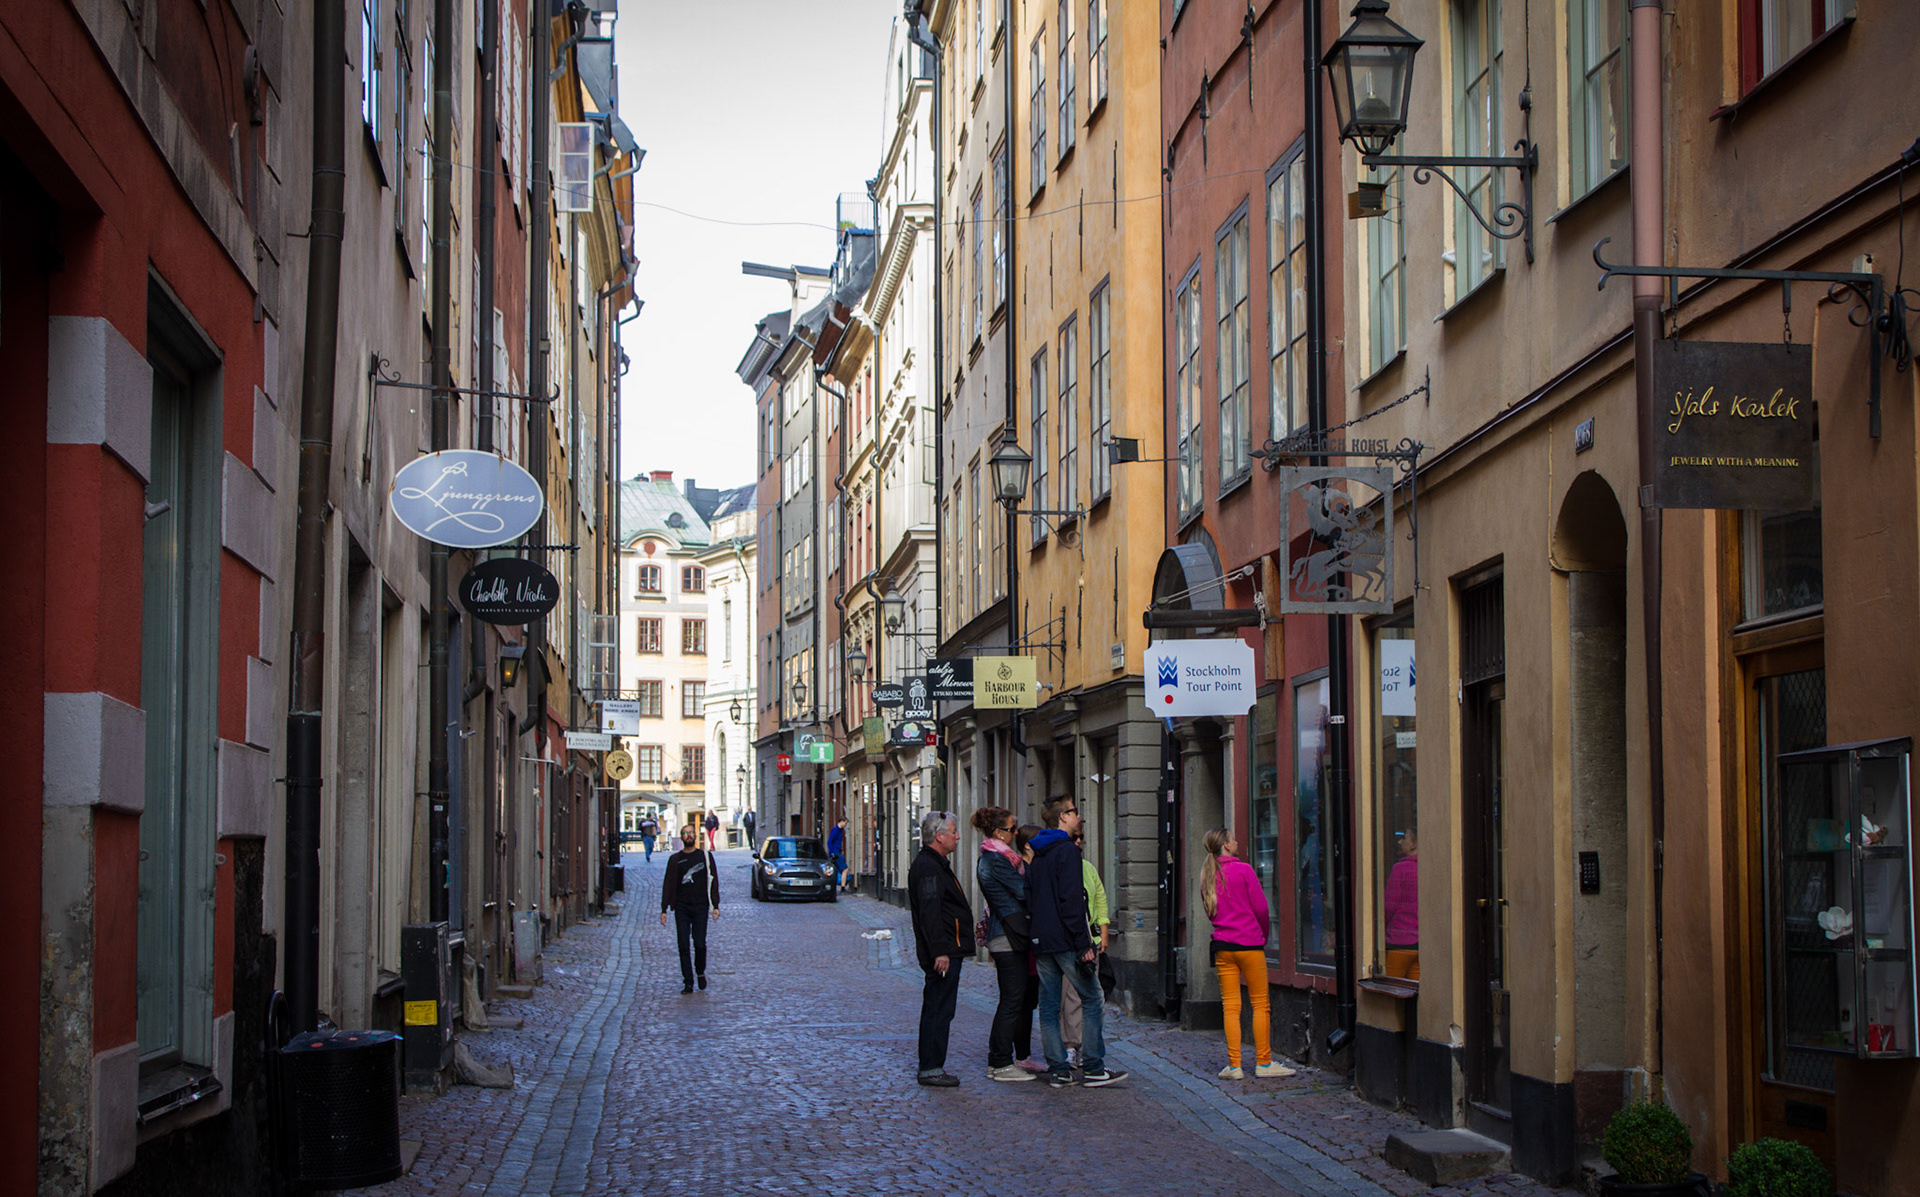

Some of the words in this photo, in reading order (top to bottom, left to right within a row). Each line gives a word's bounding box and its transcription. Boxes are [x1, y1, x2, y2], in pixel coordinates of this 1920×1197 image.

[1670, 456, 1714, 466] JEWELRY
[1716, 457, 1743, 466] WITH
[1745, 457, 1753, 466] A
[1754, 457, 1799, 467] MEANING
[399, 461, 535, 533] Ljunggrens
[1185, 665, 1241, 677] Stockholm
[985, 681, 1026, 692] HARBOUR
[1186, 682, 1211, 692] Tour
[1215, 681, 1242, 691] Point
[992, 693, 1020, 704] HOUSE
[905, 710, 932, 718] gooey
